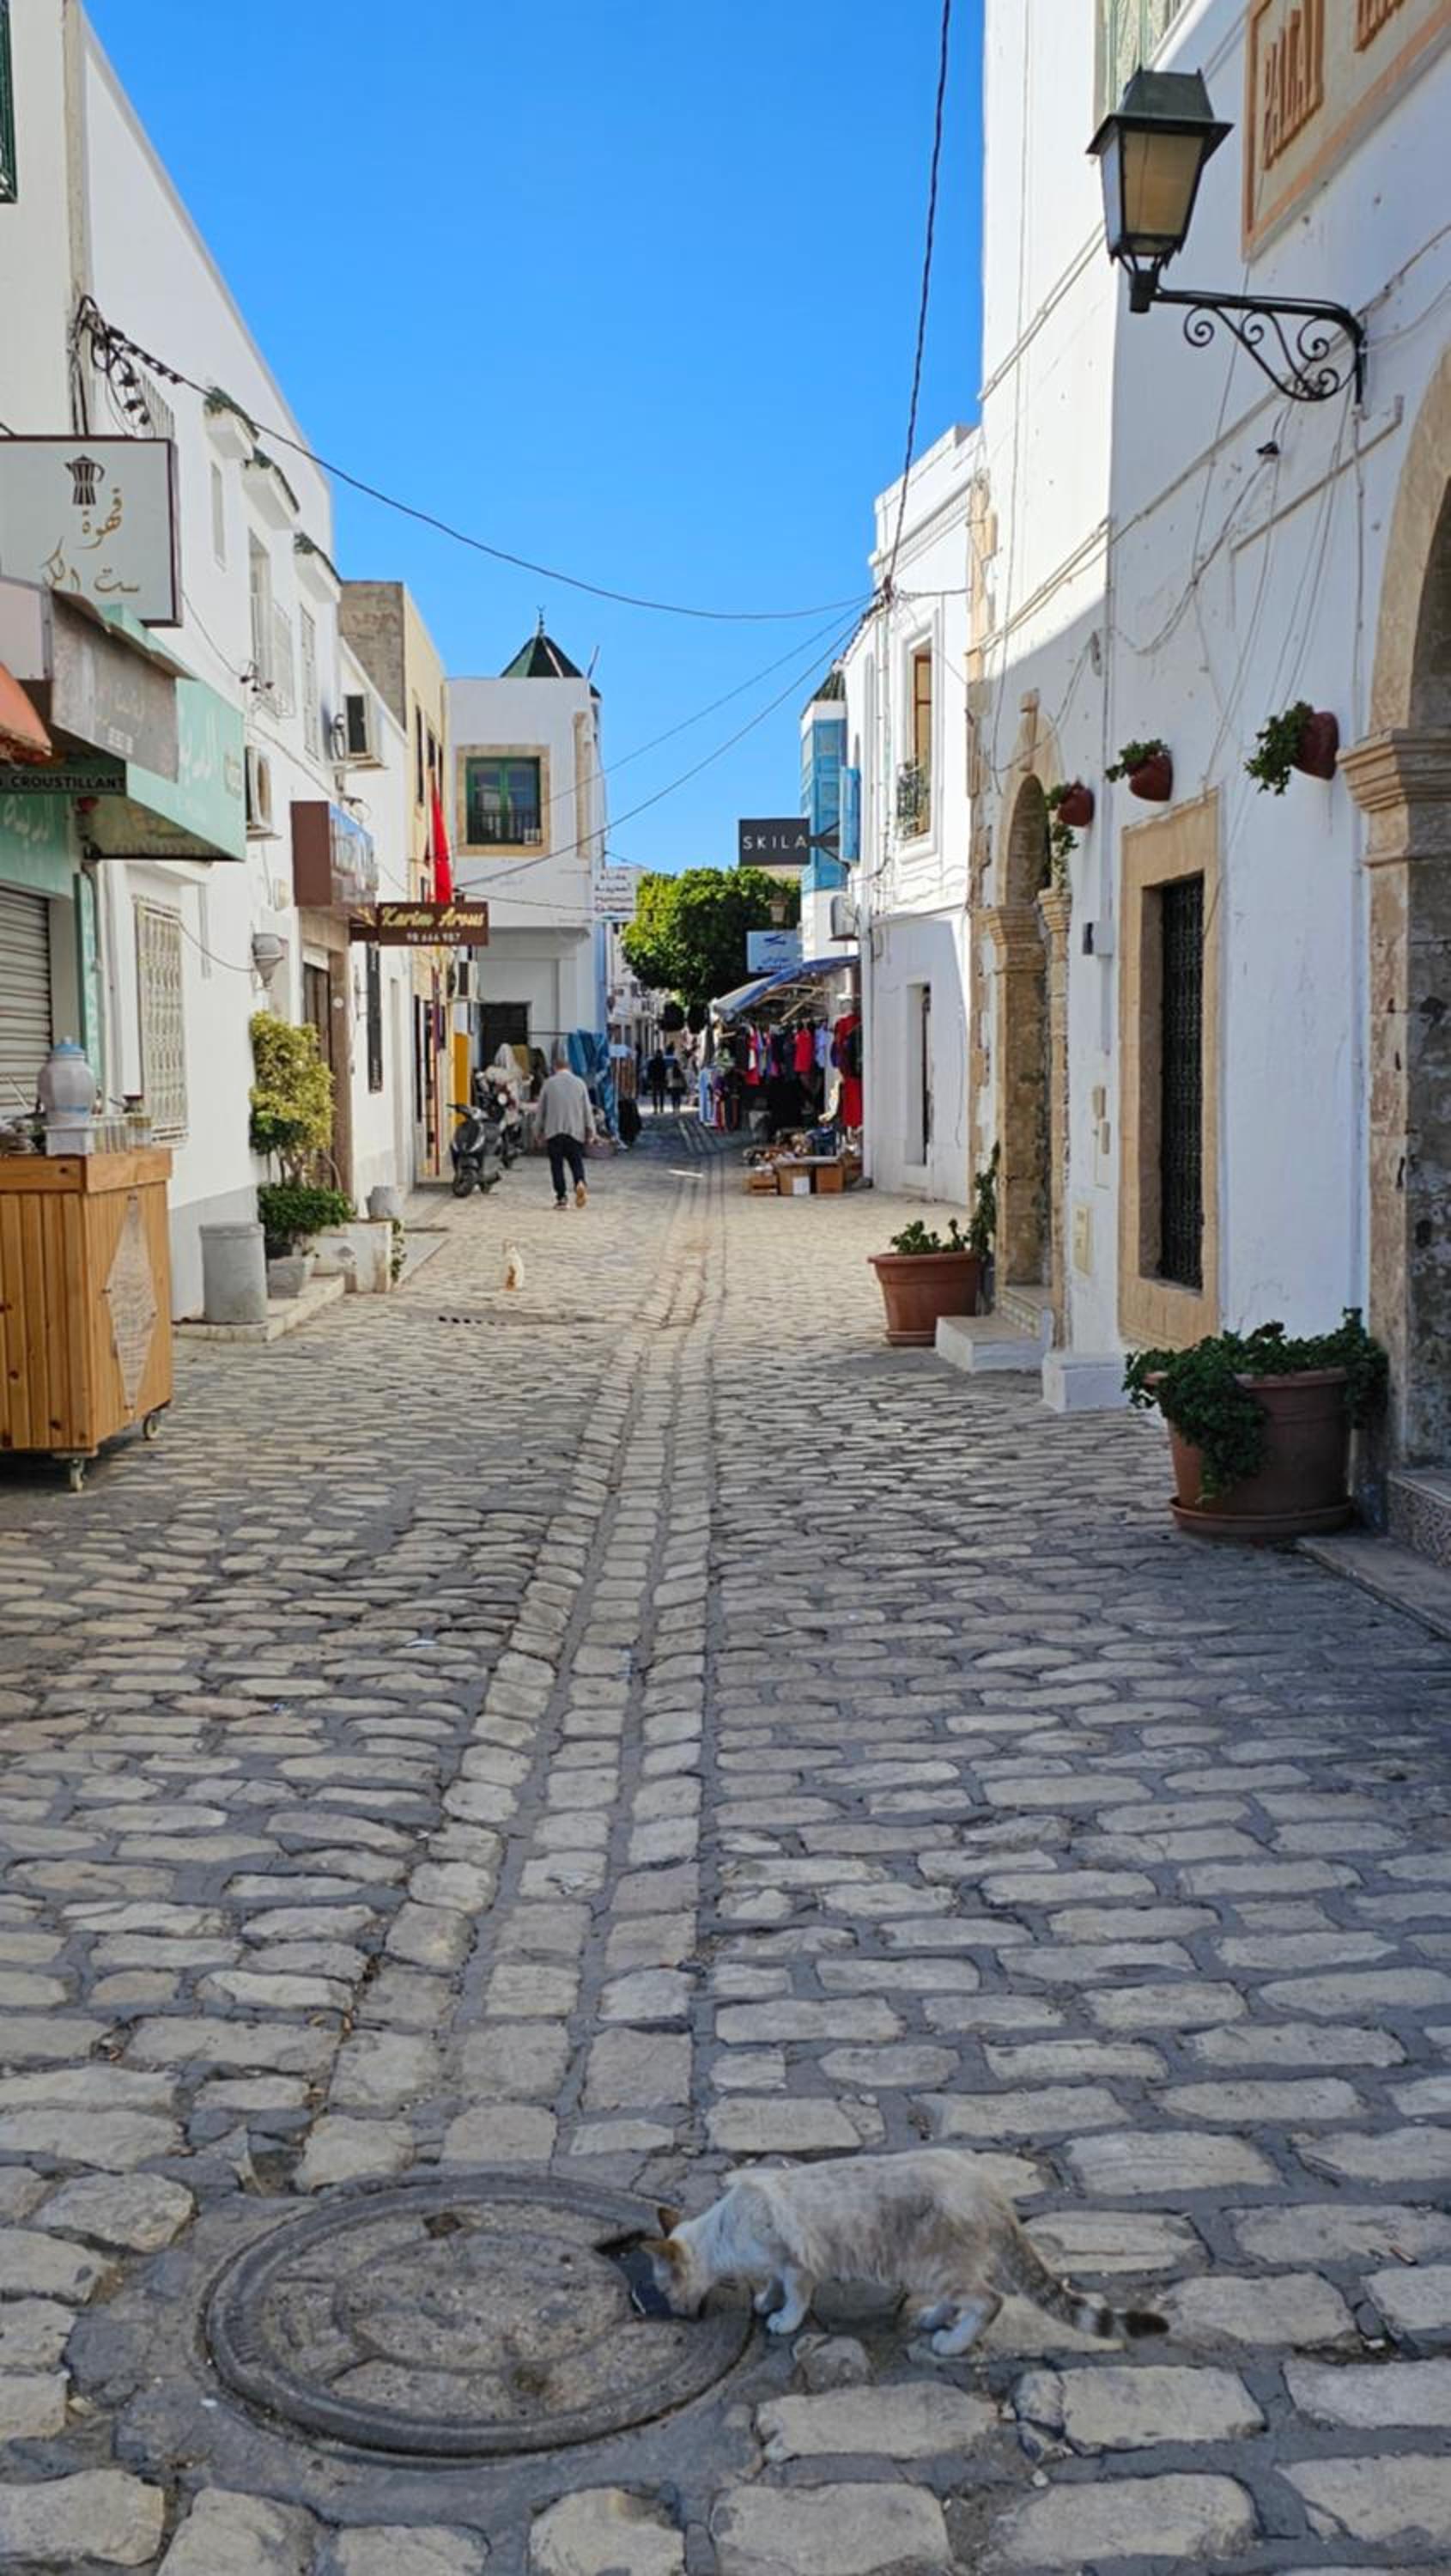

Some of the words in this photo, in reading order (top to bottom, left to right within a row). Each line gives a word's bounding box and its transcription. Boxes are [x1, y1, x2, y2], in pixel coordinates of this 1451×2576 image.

[76, 487, 123, 549] قهوة
[94, 567, 140, 592] ست
[743, 835, 807, 850] SKILA
